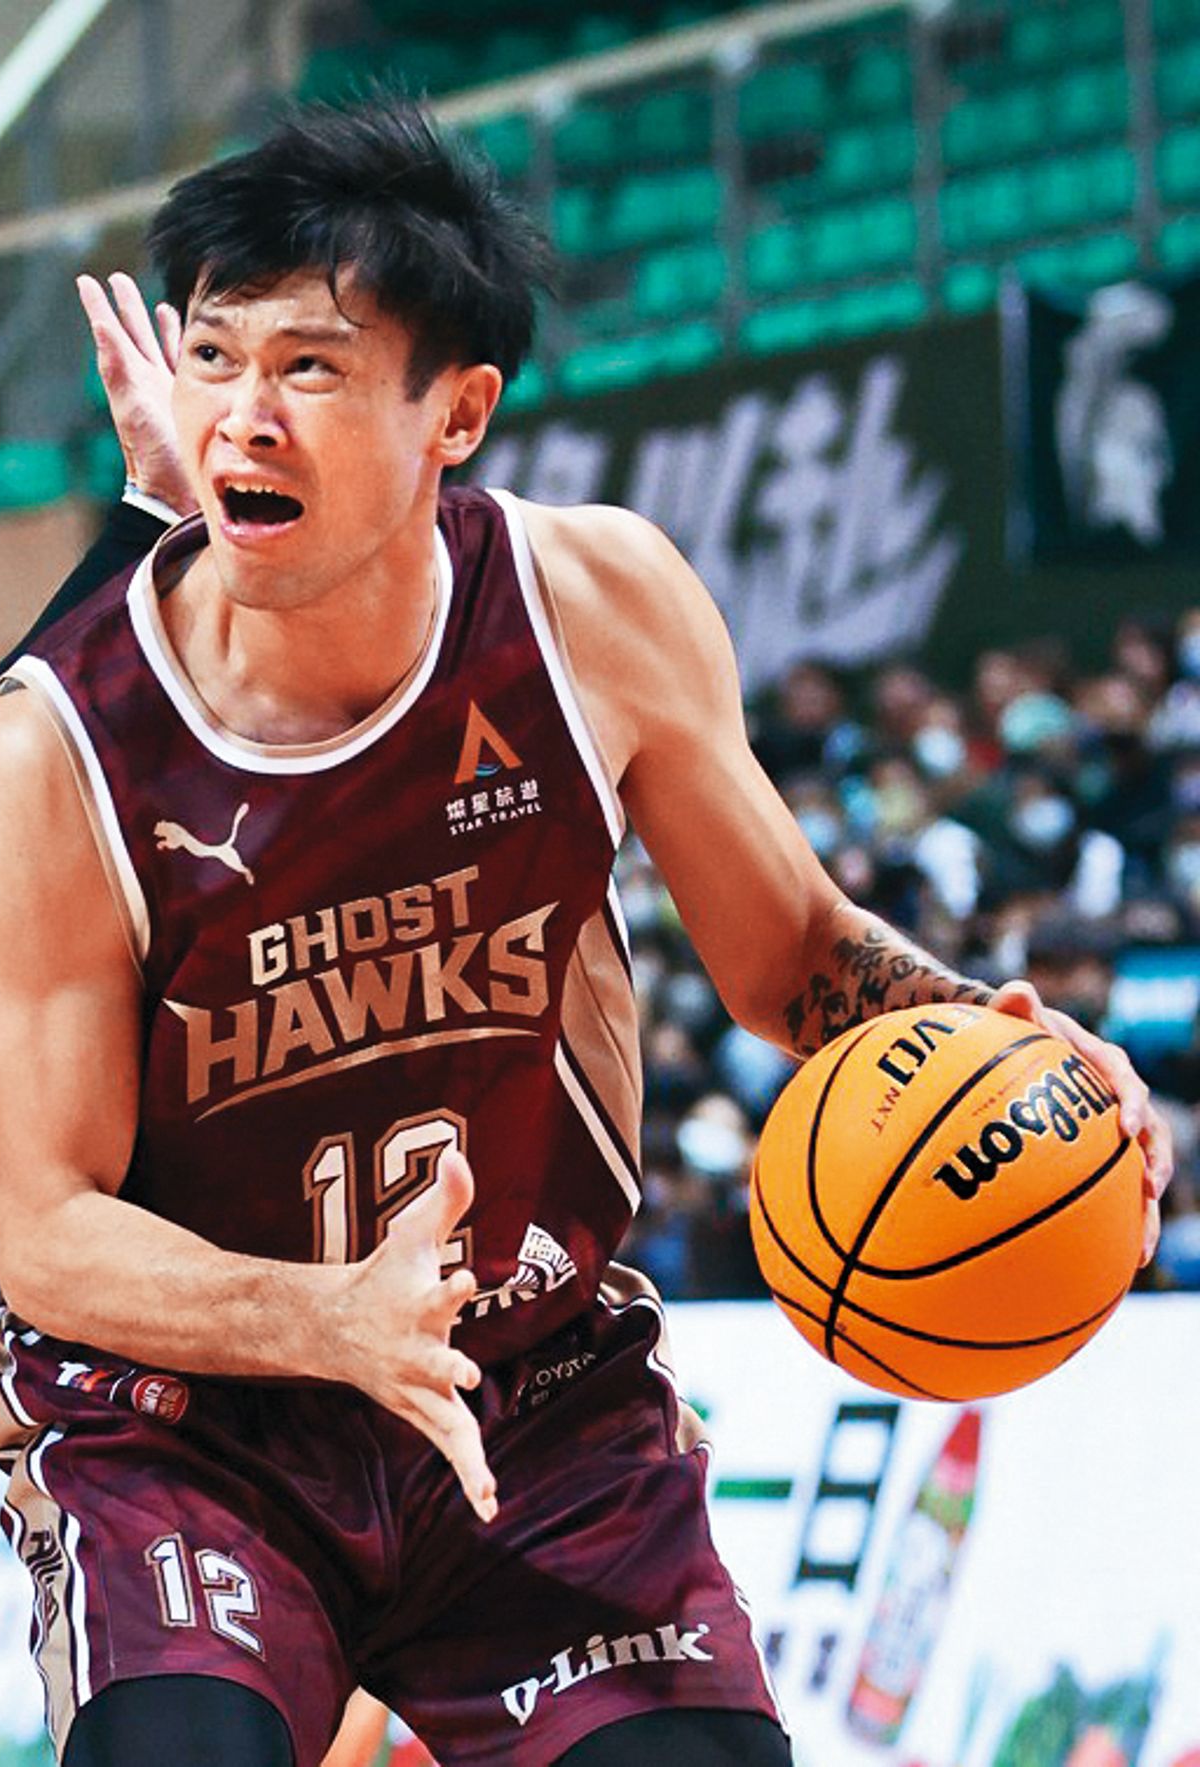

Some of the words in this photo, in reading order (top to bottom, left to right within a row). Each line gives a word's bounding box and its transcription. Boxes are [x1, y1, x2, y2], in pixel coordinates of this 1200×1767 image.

[449, 817, 484, 836] STAR
[489, 801, 543, 824] TRAVEL
[247, 864, 480, 987] GHOST
[161, 900, 561, 1105] HAWKS
[302, 1107, 475, 1280] 12
[932, 1053, 1122, 1201] Wilson
[143, 1531, 268, 1663] 12
